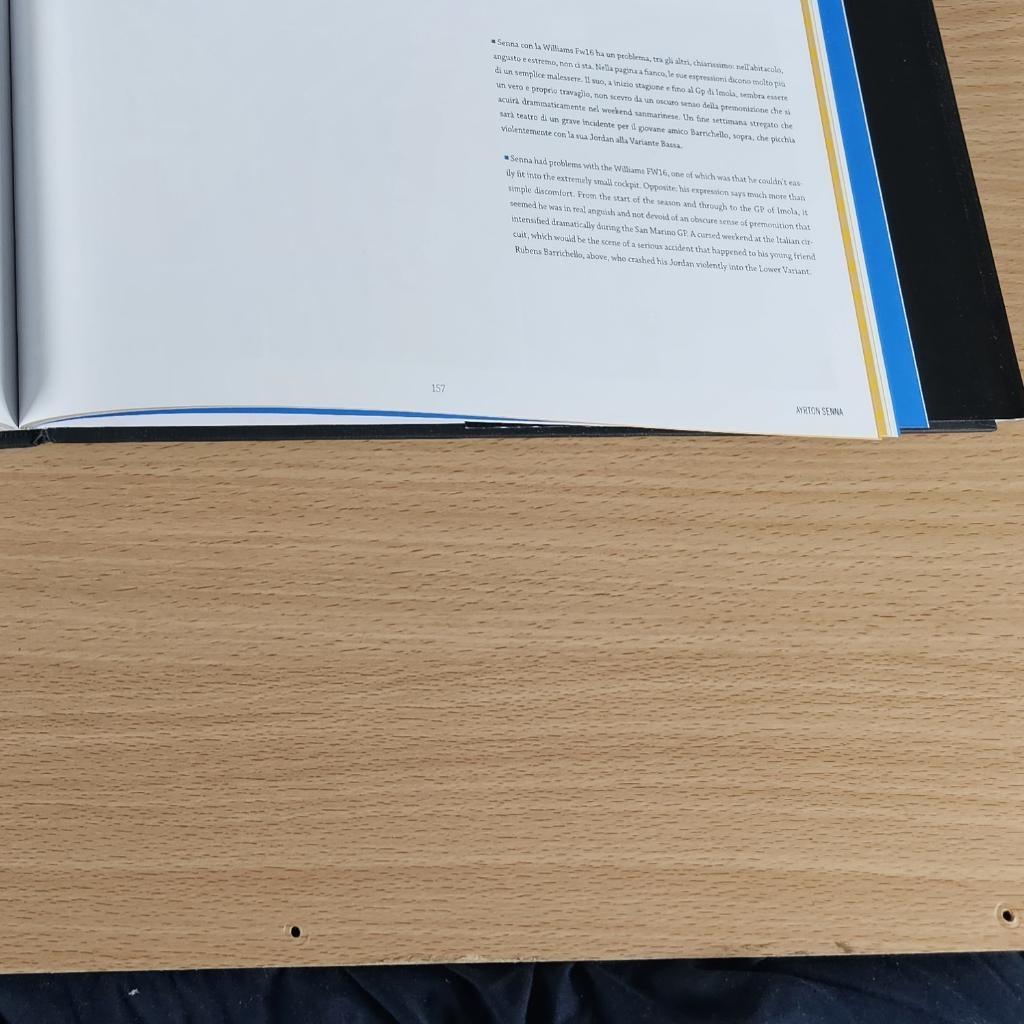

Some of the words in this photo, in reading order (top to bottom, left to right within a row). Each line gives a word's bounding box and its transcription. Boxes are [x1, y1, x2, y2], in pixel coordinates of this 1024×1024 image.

[501, 124, 552, 136] violentemente
[589, 133, 614, 142] Jordan
[629, 137, 659, 146] Variante
[660, 140, 682, 148] Bassa.
[510, 154, 532, 163] Senna
[533, 157, 547, 165] had
[548, 159, 581, 168] problems
[583, 162, 599, 170] with
[600, 163, 612, 171] the
[613, 164, 644, 174] Williams
[694, 172, 715, 180] which
[731, 174, 746, 182] that
[747, 175, 756, 183] he
[506, 168, 514, 178] ily
[526, 171, 541, 179] into
[556, 175, 591, 186] extremely
[593, 178, 612, 186] small
[691, 188, 729, 196] expression
[730, 191, 745, 199] says
[788, 193, 805, 201] than
[508, 184, 531, 194] simple
[577, 190, 596, 199] From
[642, 196, 654, 204] the
[698, 201, 727, 212] through
[777, 206, 800, 216] Imola,
[511, 214, 549, 224] intensified
[551, 218, 594, 231] dramatically
[596, 222, 620, 233] during
[621, 224, 633, 232] the
[634, 225, 648, 233] San
[649, 227, 675, 235] Marino
[721, 233, 753, 241] weekend
[762, 235, 774, 243] the
[776, 236, 799, 244] Italian
[587, 208, 615, 216] anguish
[645, 211, 669, 220] devoid
[690, 215, 717, 224] obscure
[749, 221, 794, 229] premonition
[795, 222, 810, 230] that
[512, 230, 529, 239] cuit,
[530, 232, 552, 240] which
[637, 241, 662, 249] serious
[664, 243, 693, 252] accident
[695, 245, 709, 253] that
[711, 246, 746, 257] happened
[757, 249, 768, 257] his
[769, 252, 792, 261] young
[793, 252, 815, 260] friend
[514, 245, 541, 254] Rubens
[543, 248, 584, 259] Barrichello,
[586, 252, 609, 262] above,
[610, 254, 626, 262] who
[627, 256, 655, 264] crashed
[656, 257, 667, 265] his
[669, 258, 694, 267] Jordan
[695, 260, 727, 271] violently
[728, 262, 743, 270] into
[758, 264, 780, 273] Lower
[432, 383, 446, 393] 157
[796, 406, 821, 416] AYRTON
[821, 407, 844, 416] SENNA
